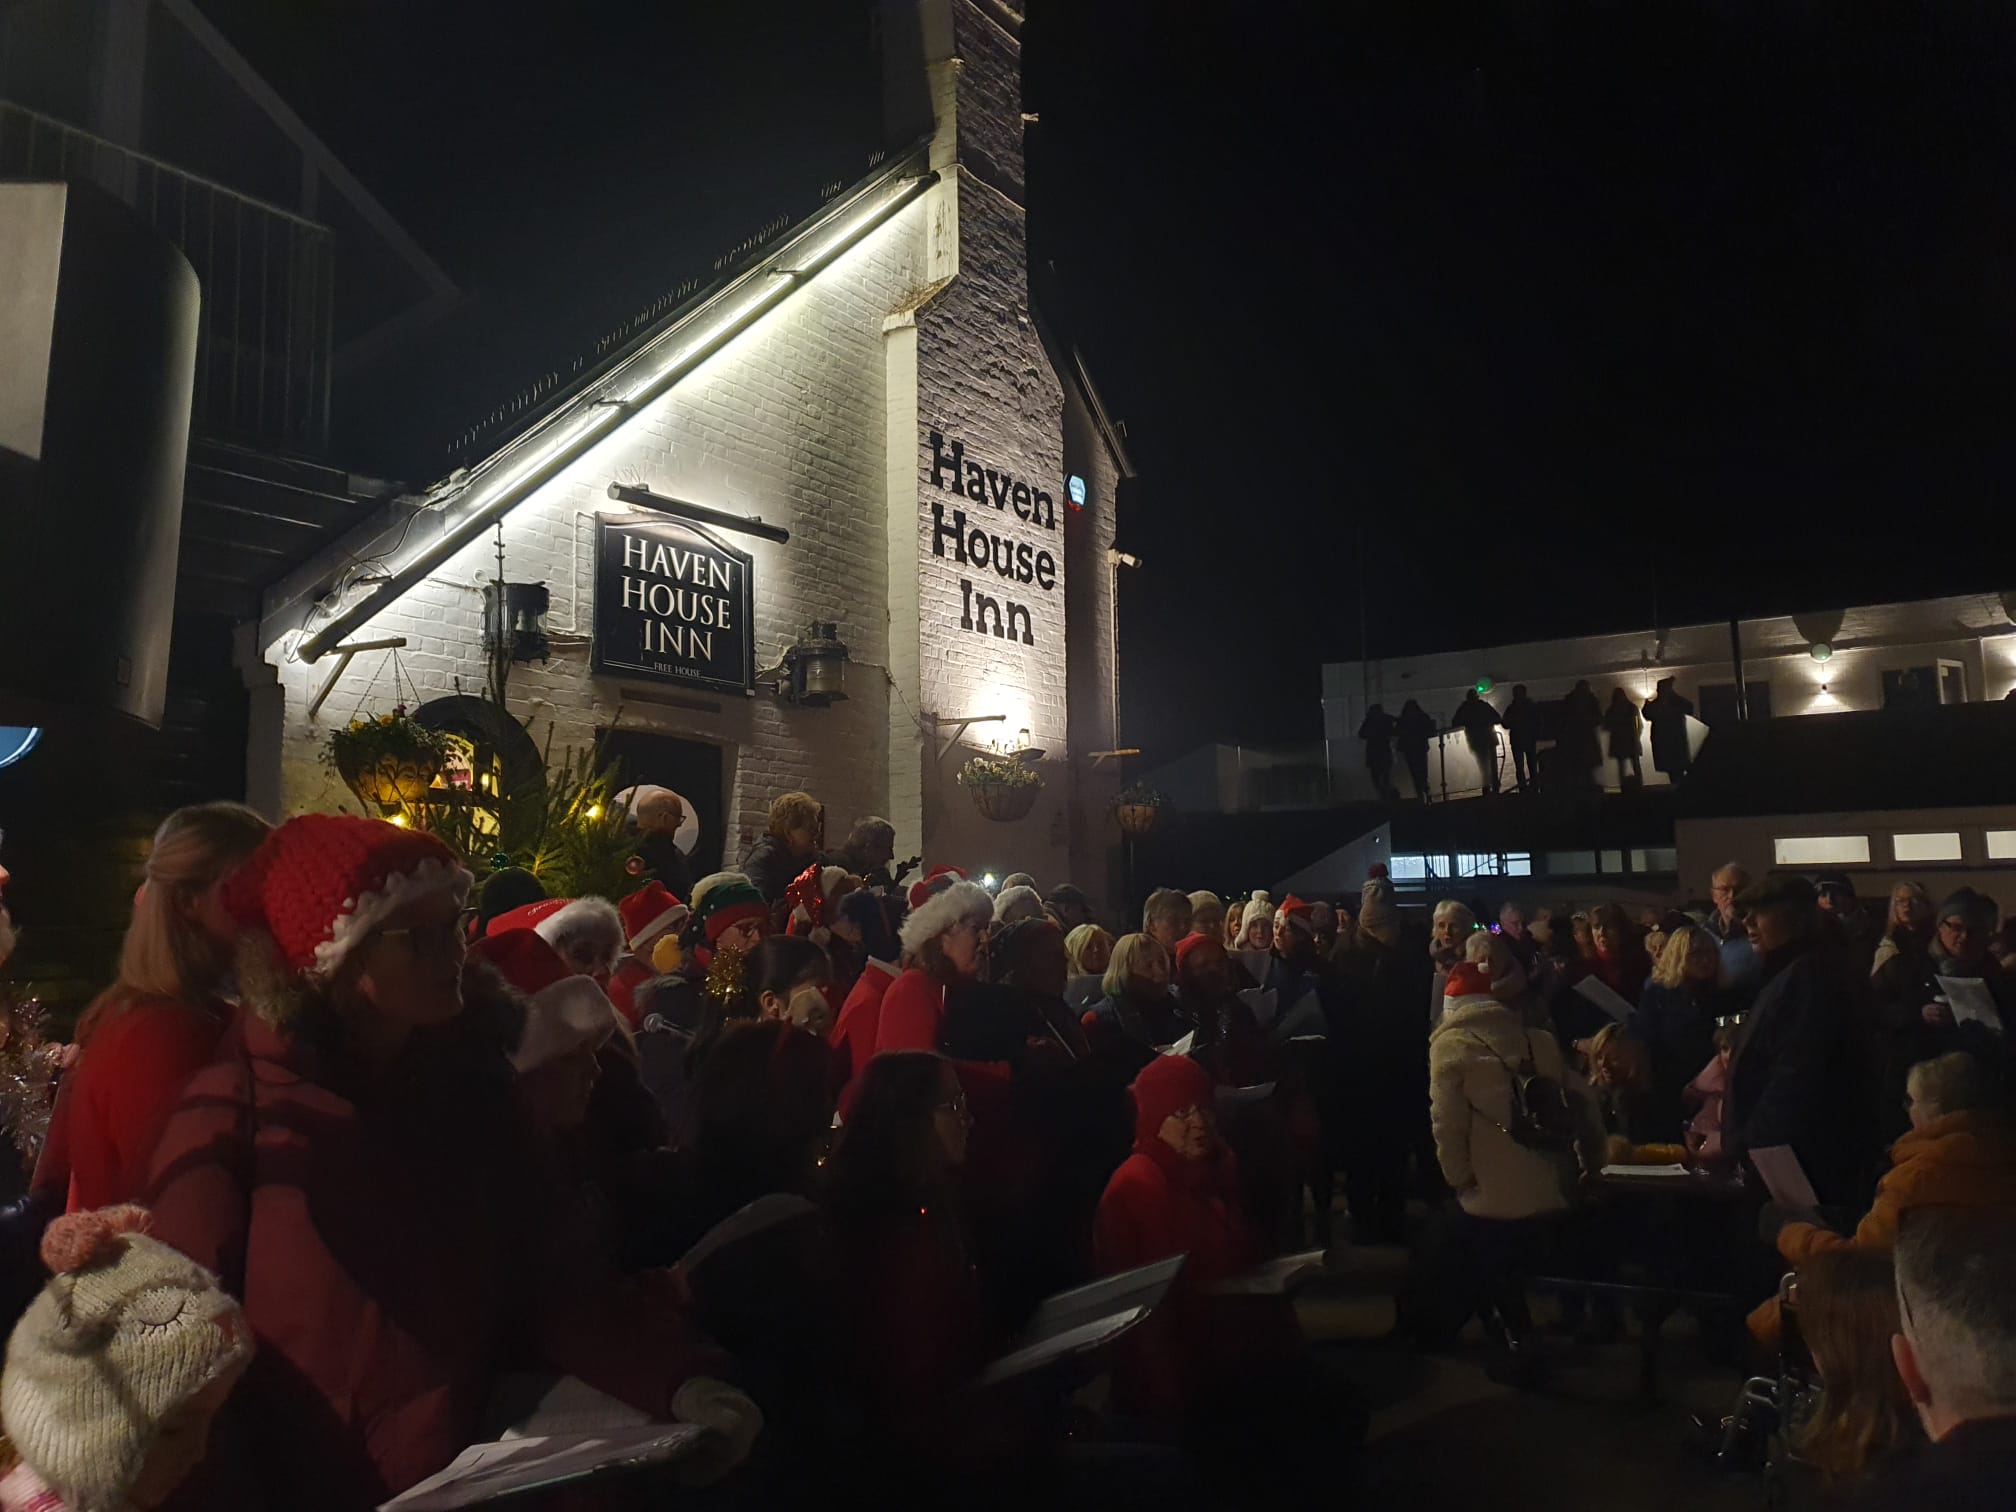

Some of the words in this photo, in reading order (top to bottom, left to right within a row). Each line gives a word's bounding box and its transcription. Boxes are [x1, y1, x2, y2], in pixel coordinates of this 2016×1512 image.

[930, 430, 1055, 530] Haven
[622, 534, 731, 592] HAVEN
[931, 502, 1055, 590] House
[621, 575, 731, 630] HOUSE
[960, 579, 1034, 646] Inn
[643, 618, 713, 662] INN
[654, 661, 673, 673] FREE
[675, 665, 701, 678] HOUSE
